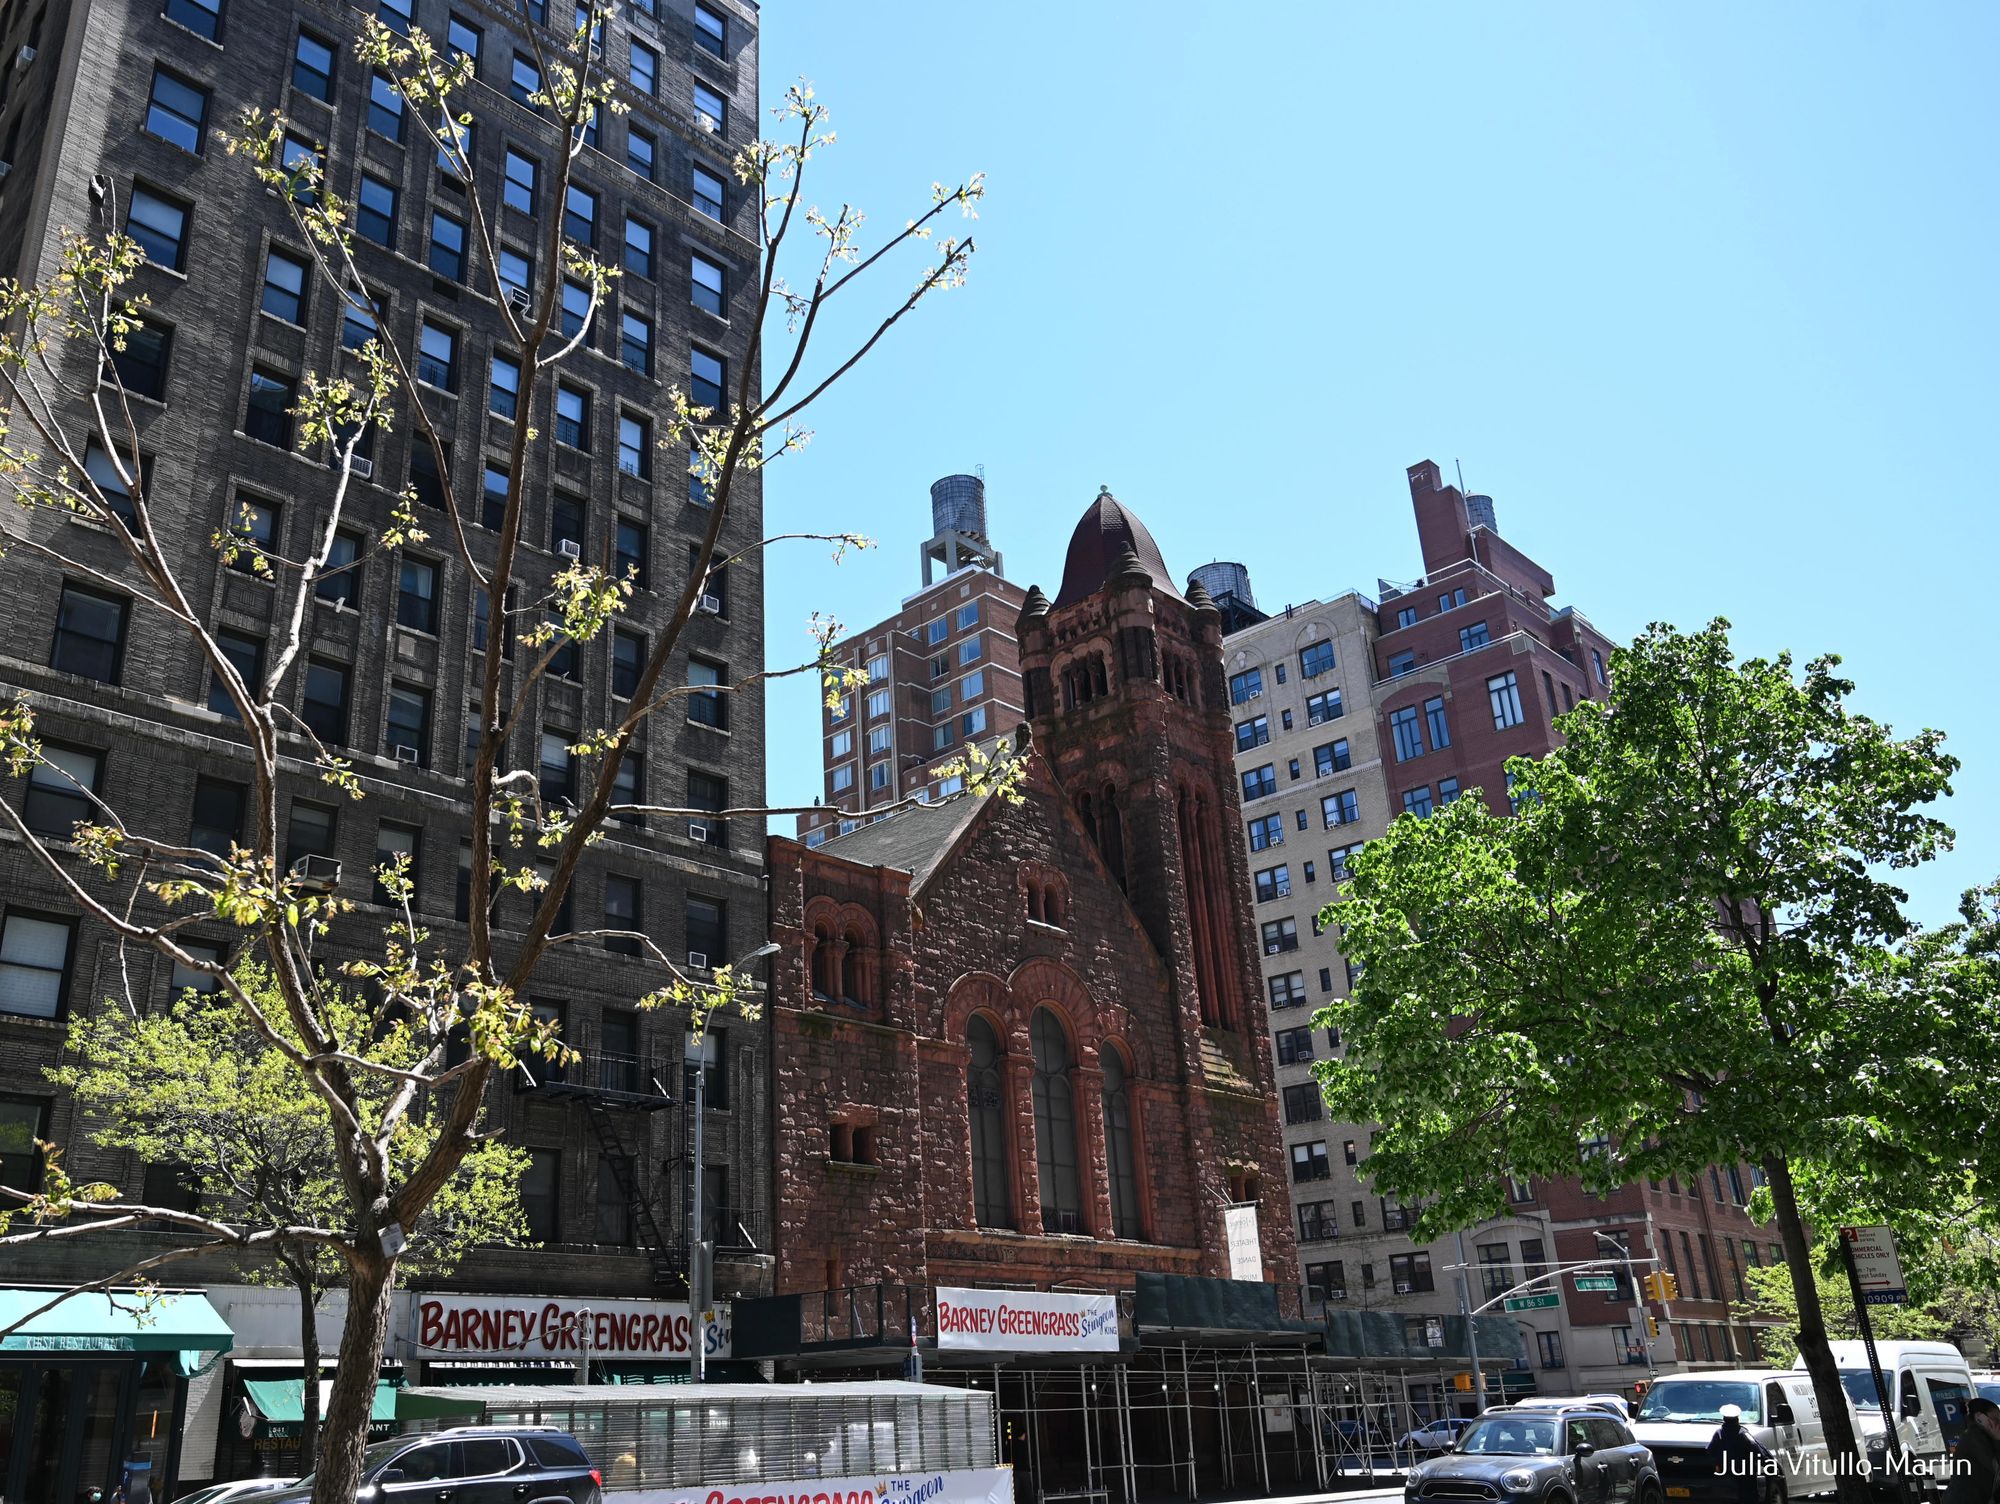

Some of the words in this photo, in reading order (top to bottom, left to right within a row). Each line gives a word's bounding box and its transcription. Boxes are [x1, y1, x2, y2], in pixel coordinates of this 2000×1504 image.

[1851, 1245, 1883, 1253] OMMERCIAL
[1526, 1299, 1536, 1307] 86
[1538, 1298, 1545, 1306] St
[1087, 1308, 1098, 1316] THE
[938, 1301, 996, 1334] BARNEY
[998, 1304, 1080, 1337] GREENGRASS
[1081, 1309, 1114, 1338] Sturgeon
[420, 1301, 538, 1350] BARNEY
[1105, 1326, 1118, 1335] KING
[891, 1479, 910, 1492] THE
